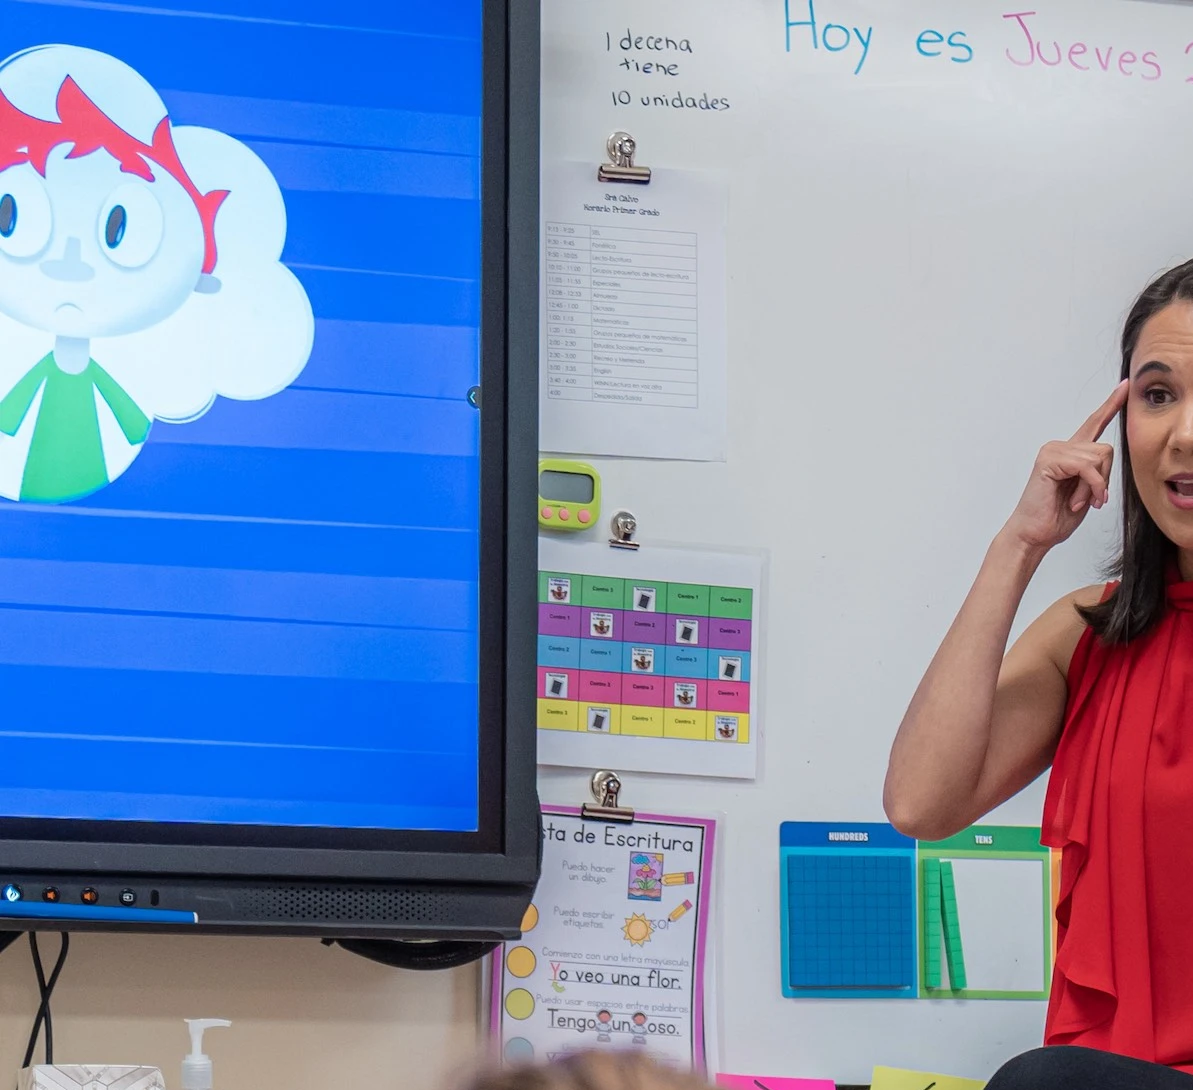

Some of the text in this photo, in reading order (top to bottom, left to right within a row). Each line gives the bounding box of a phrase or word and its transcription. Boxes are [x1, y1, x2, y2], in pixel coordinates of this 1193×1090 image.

[619, 28, 693, 53] decena
[783, 0, 874, 74] Hoy
[915, 26, 975, 64] es
[1003, 11, 1163, 82] Jueves
[618, 58, 680, 76] tiene
[612, 90, 731, 111] 10 unidades
[574, 824, 596, 843] de
[604, 825, 694, 853] Escritura
[828, 831, 869, 843] HUNDREDS
[975, 834, 994, 845] TENS
[562, 860, 616, 873] Puedo hacer
[568, 873, 579, 881] un
[553, 906, 615, 920] Puedo escribir
[542, 946, 583, 960] Comienzo
[585, 953, 601, 961] con
[603, 954, 619, 962] una
[621, 953, 643, 965] letra
[550, 962, 682, 990] Yo veo una flor.
[536, 993, 562, 1005] Puedo
[564, 998, 584, 1006] usar
[587, 998, 623, 1010] espacios
[625, 1001, 650, 1011] entre
[547, 1007, 680, 1035] Tengo un oso.
